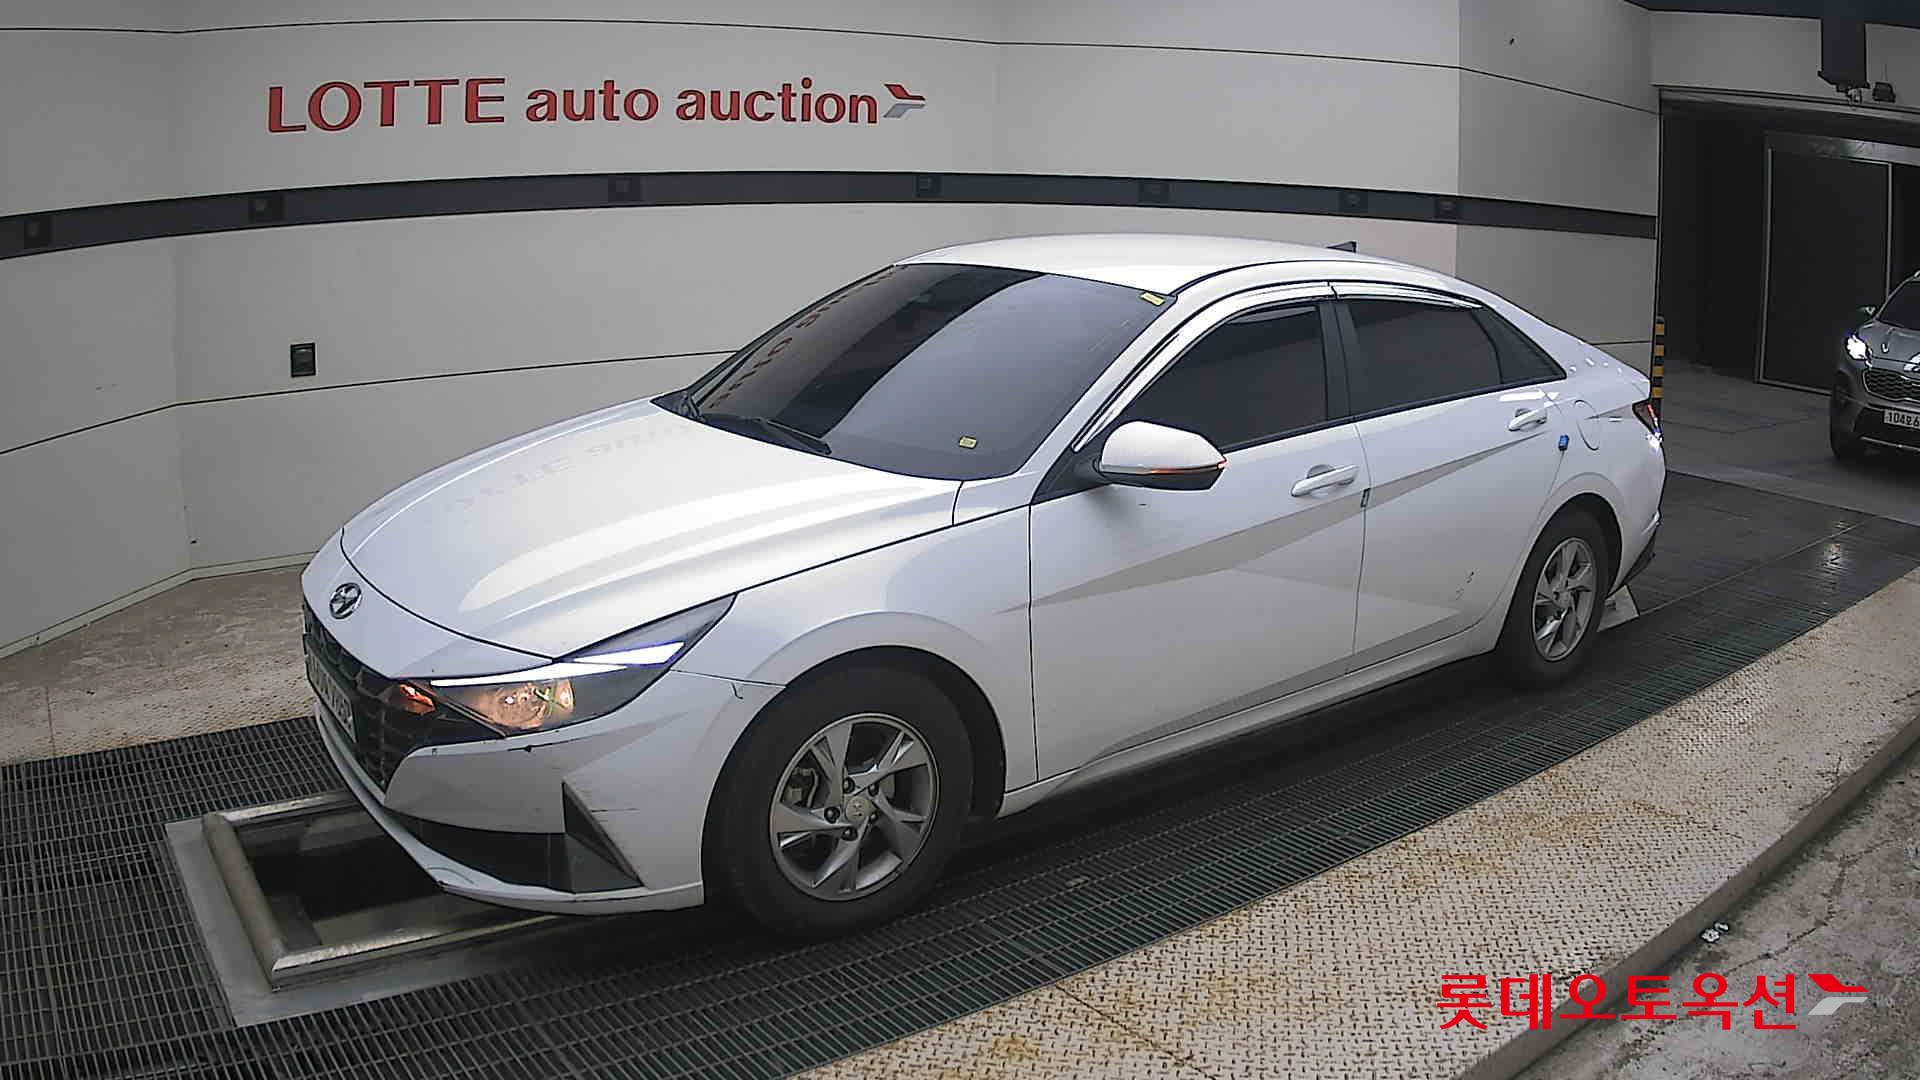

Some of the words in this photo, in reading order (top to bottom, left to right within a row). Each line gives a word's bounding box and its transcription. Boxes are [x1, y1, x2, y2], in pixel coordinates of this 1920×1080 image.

[267, 77, 505, 133] LOTTE
[525, 79, 659, 122] auto
[675, 77, 879, 124] auction
